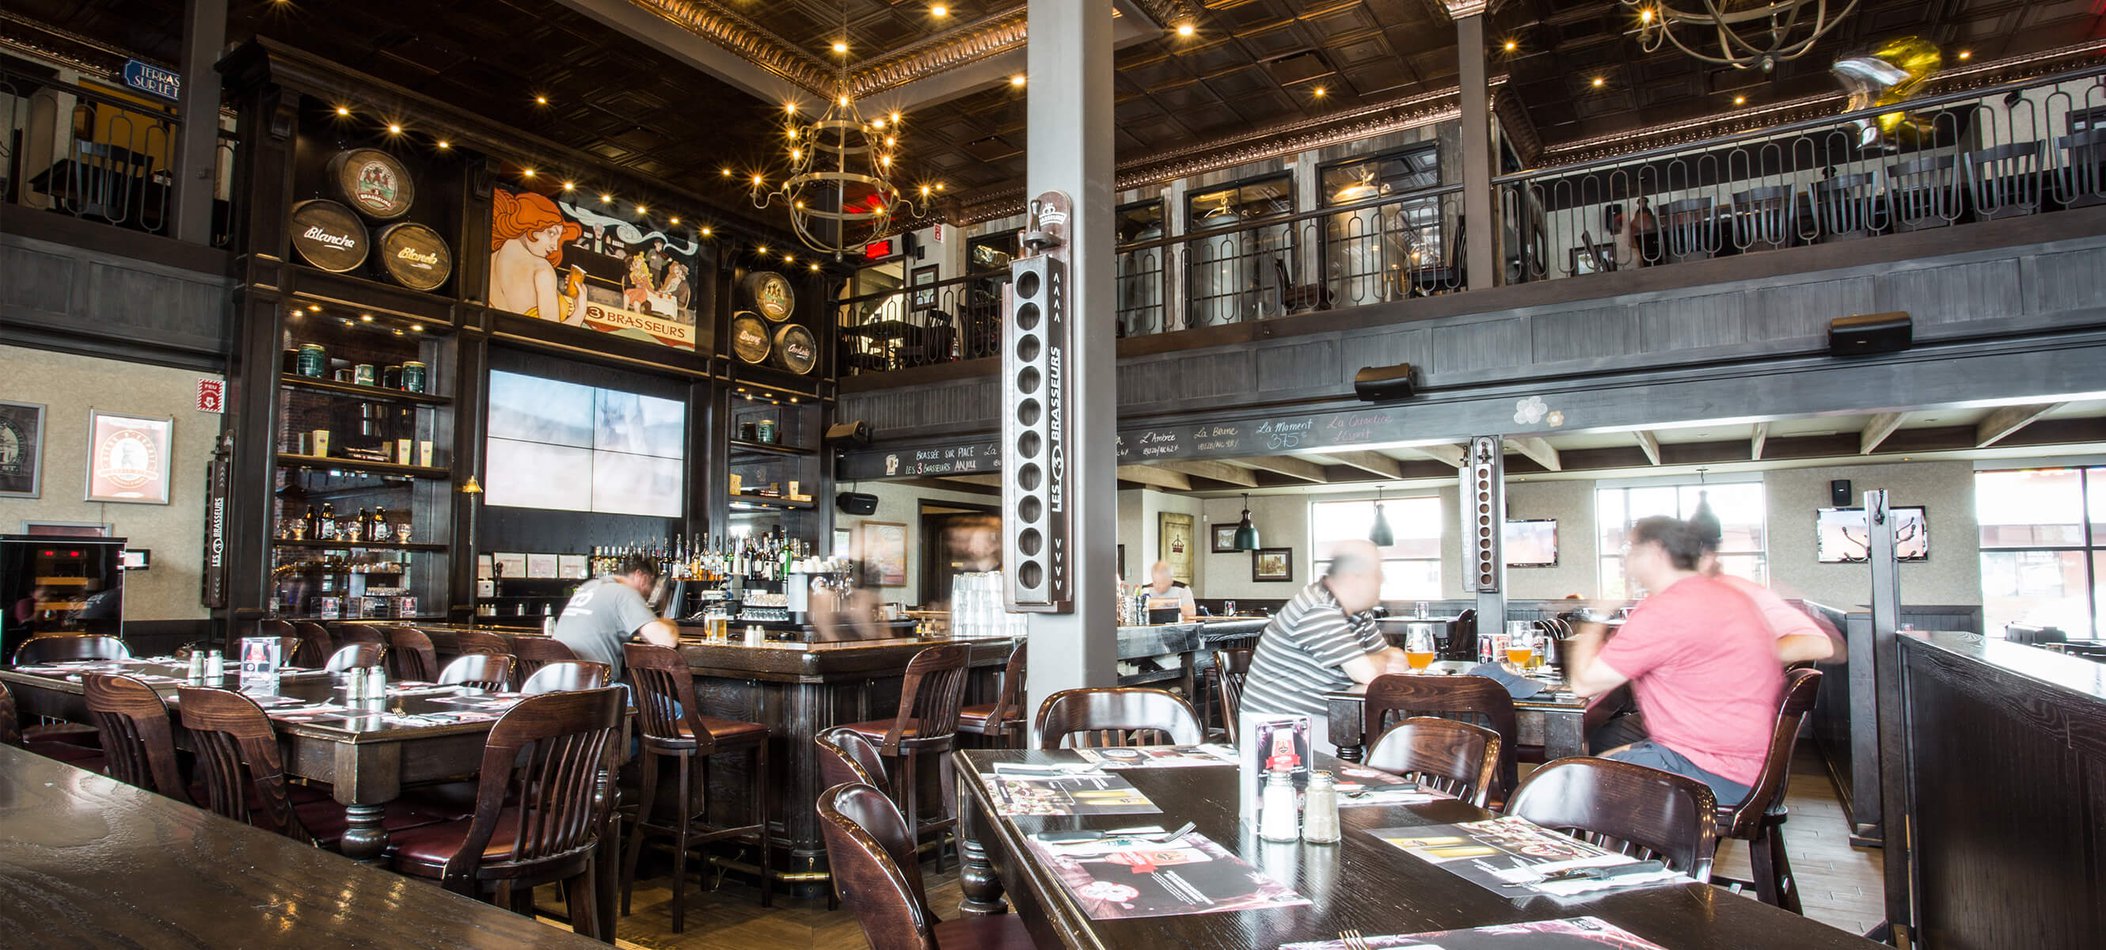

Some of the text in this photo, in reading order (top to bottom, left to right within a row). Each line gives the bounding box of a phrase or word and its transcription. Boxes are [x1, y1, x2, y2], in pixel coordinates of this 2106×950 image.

[133, 75, 156, 92] SUR
[304, 225, 355, 248] Blanche
[607, 311, 685, 339] BRASSEURS
[1050, 346, 1061, 441] BRASSEURS
[1194, 427, 1207, 439] La
[1256, 419, 1312, 434] La Moment
[916, 446, 975, 460] BRASSÉE SUR PLACE
[984, 444, 998, 456] La
[905, 465, 916, 475] LES
[917, 462, 923, 475] 3
[954, 459, 977, 472] ANJOU
[1051, 484, 1062, 512] LES
[213, 496, 224, 538] BRASSEURS
[212, 554, 221, 567] LES
